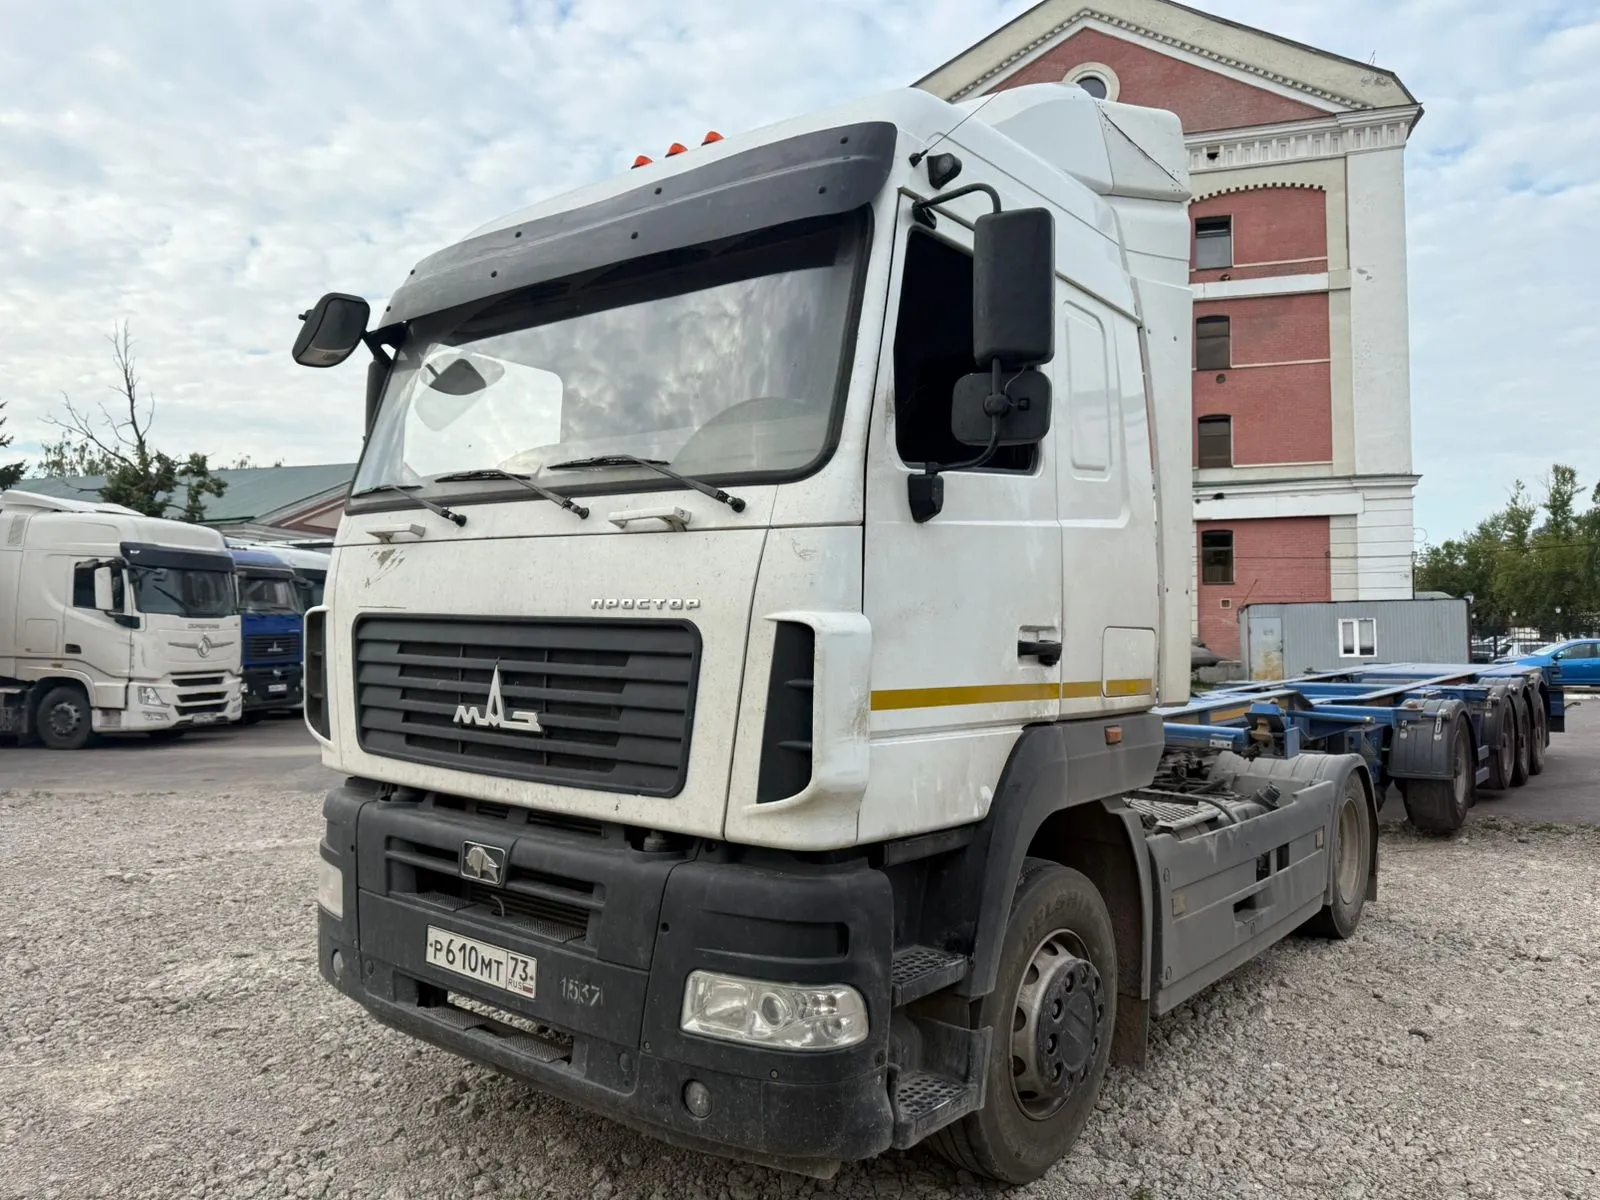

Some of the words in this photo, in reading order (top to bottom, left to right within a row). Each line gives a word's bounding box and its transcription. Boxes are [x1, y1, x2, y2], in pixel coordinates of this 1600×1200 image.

[591, 598, 700, 610] ПРОСТОР
[453, 662, 543, 732] МАЗ
[510, 956, 529, 982] 73
[508, 978, 523, 990] RUS
